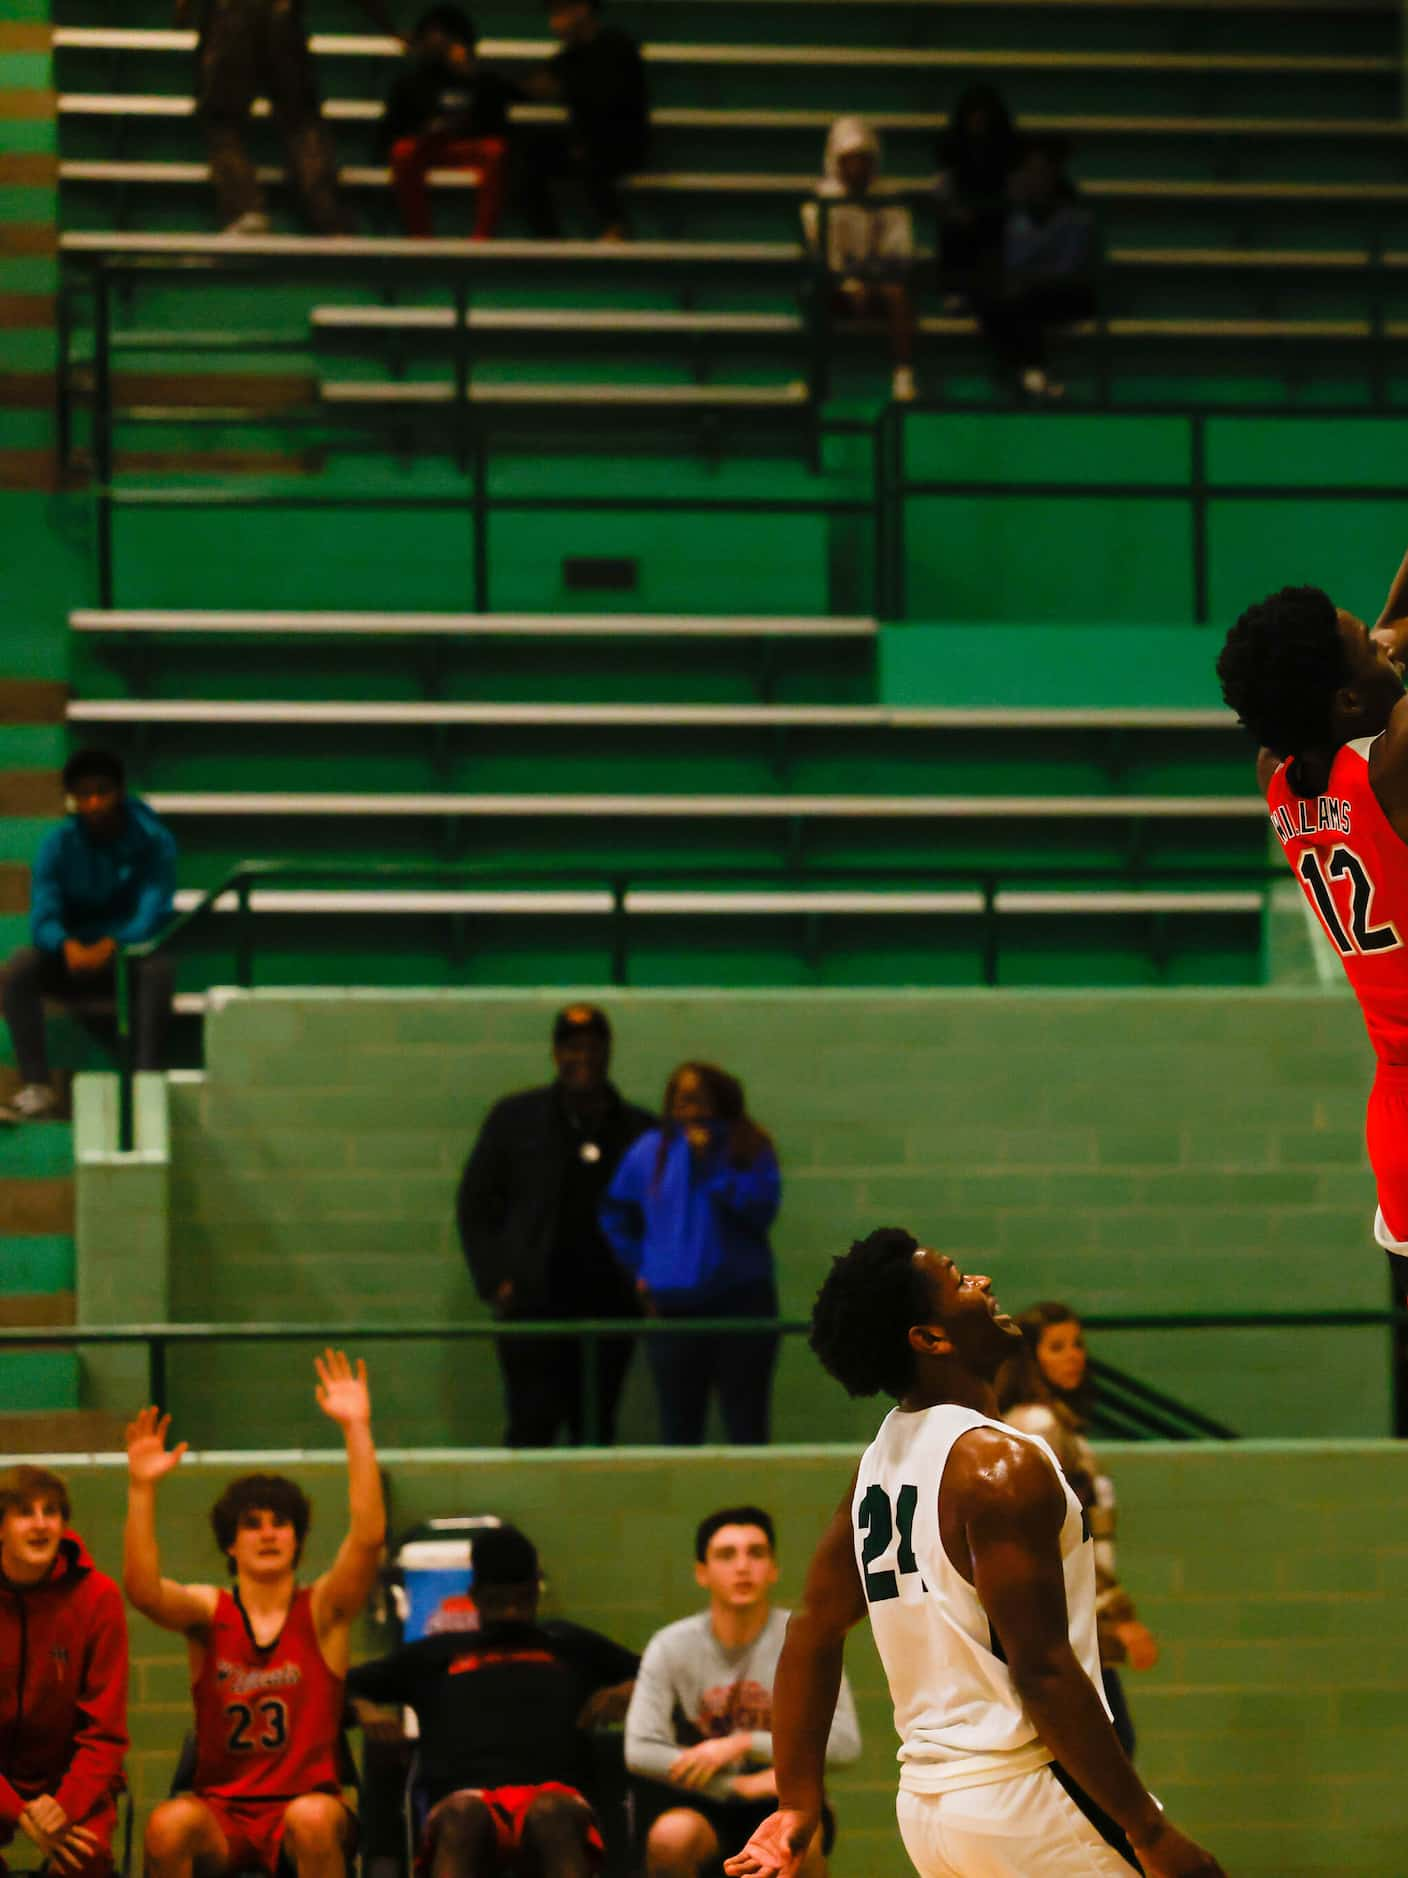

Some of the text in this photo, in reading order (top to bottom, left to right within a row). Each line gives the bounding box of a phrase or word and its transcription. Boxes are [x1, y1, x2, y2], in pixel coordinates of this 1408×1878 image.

[1270, 795, 1352, 846] WILAMS
[1298, 844, 1404, 957] 12
[226, 1697, 287, 1751] 23
